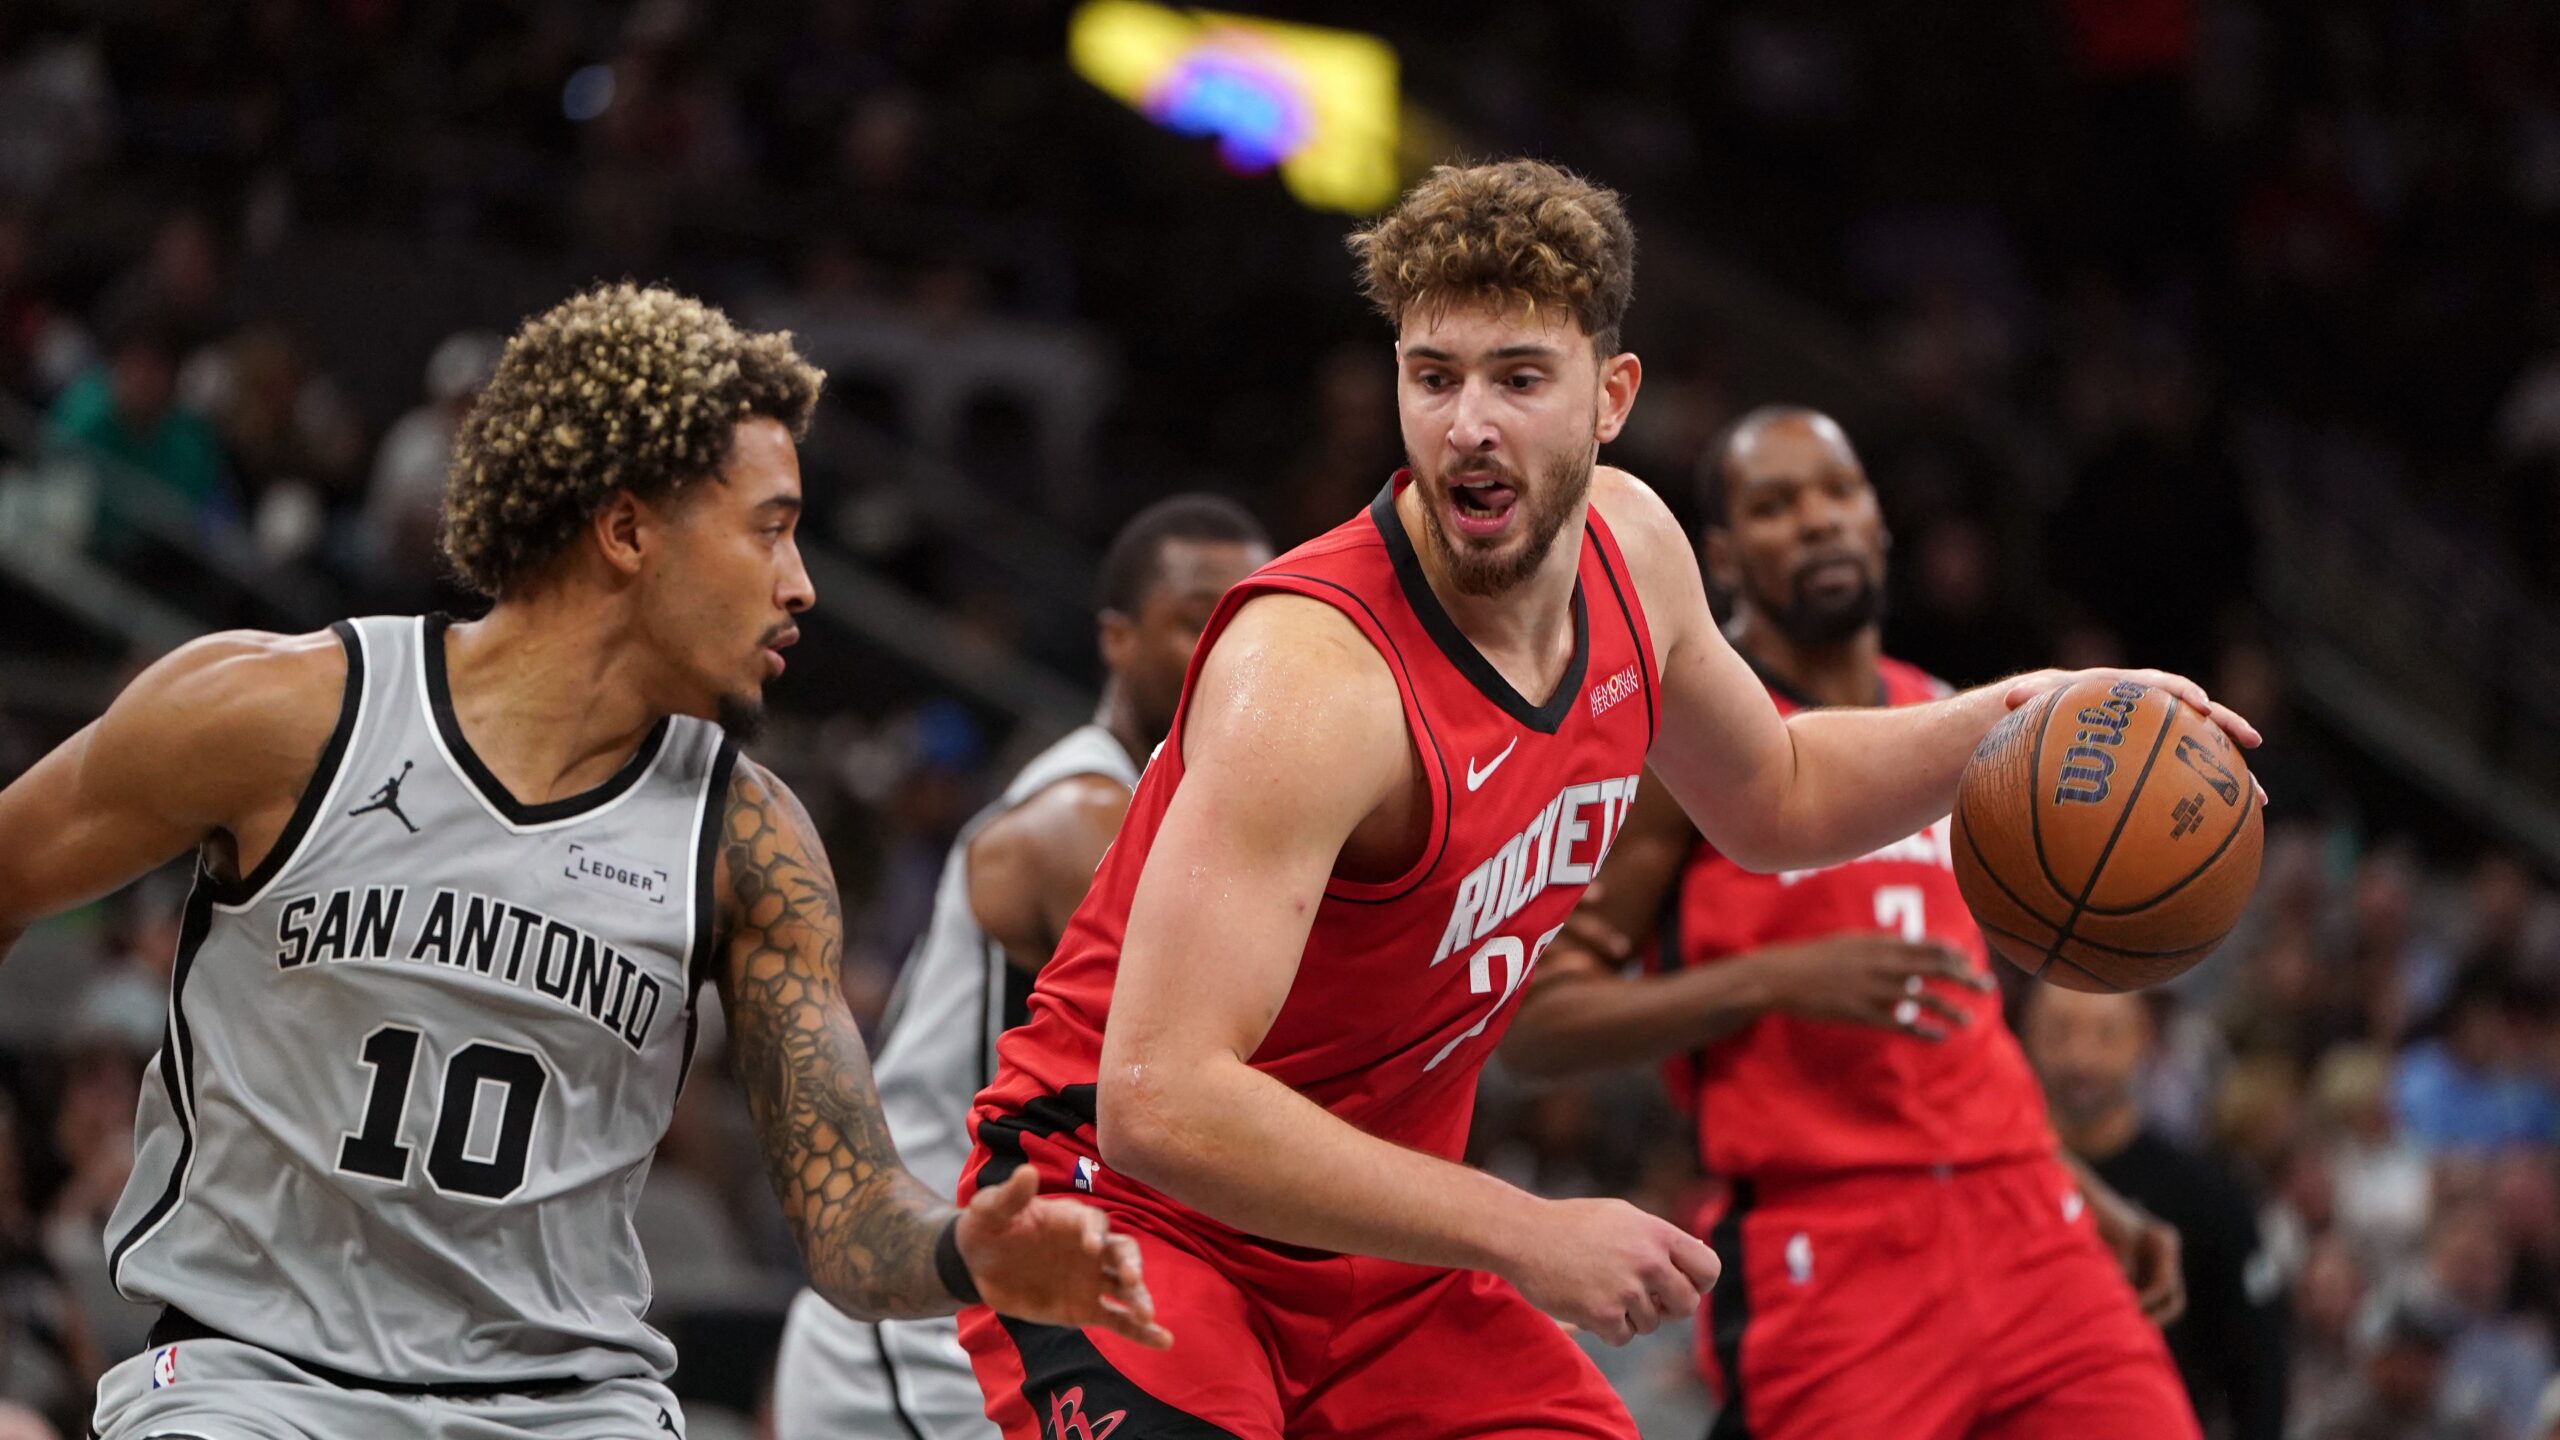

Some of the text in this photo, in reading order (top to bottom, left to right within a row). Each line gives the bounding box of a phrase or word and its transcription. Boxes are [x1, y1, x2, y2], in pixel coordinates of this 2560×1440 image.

[1589, 664, 1638, 704] MEMORIAL
[1590, 676, 1639, 719] HERMANN
[579, 856, 653, 892] LEDGER
[276, 884, 661, 1055] SAN ANTONIO
[333, 1021, 552, 1205] 10
[1075, 1178, 1088, 1190] NBA
